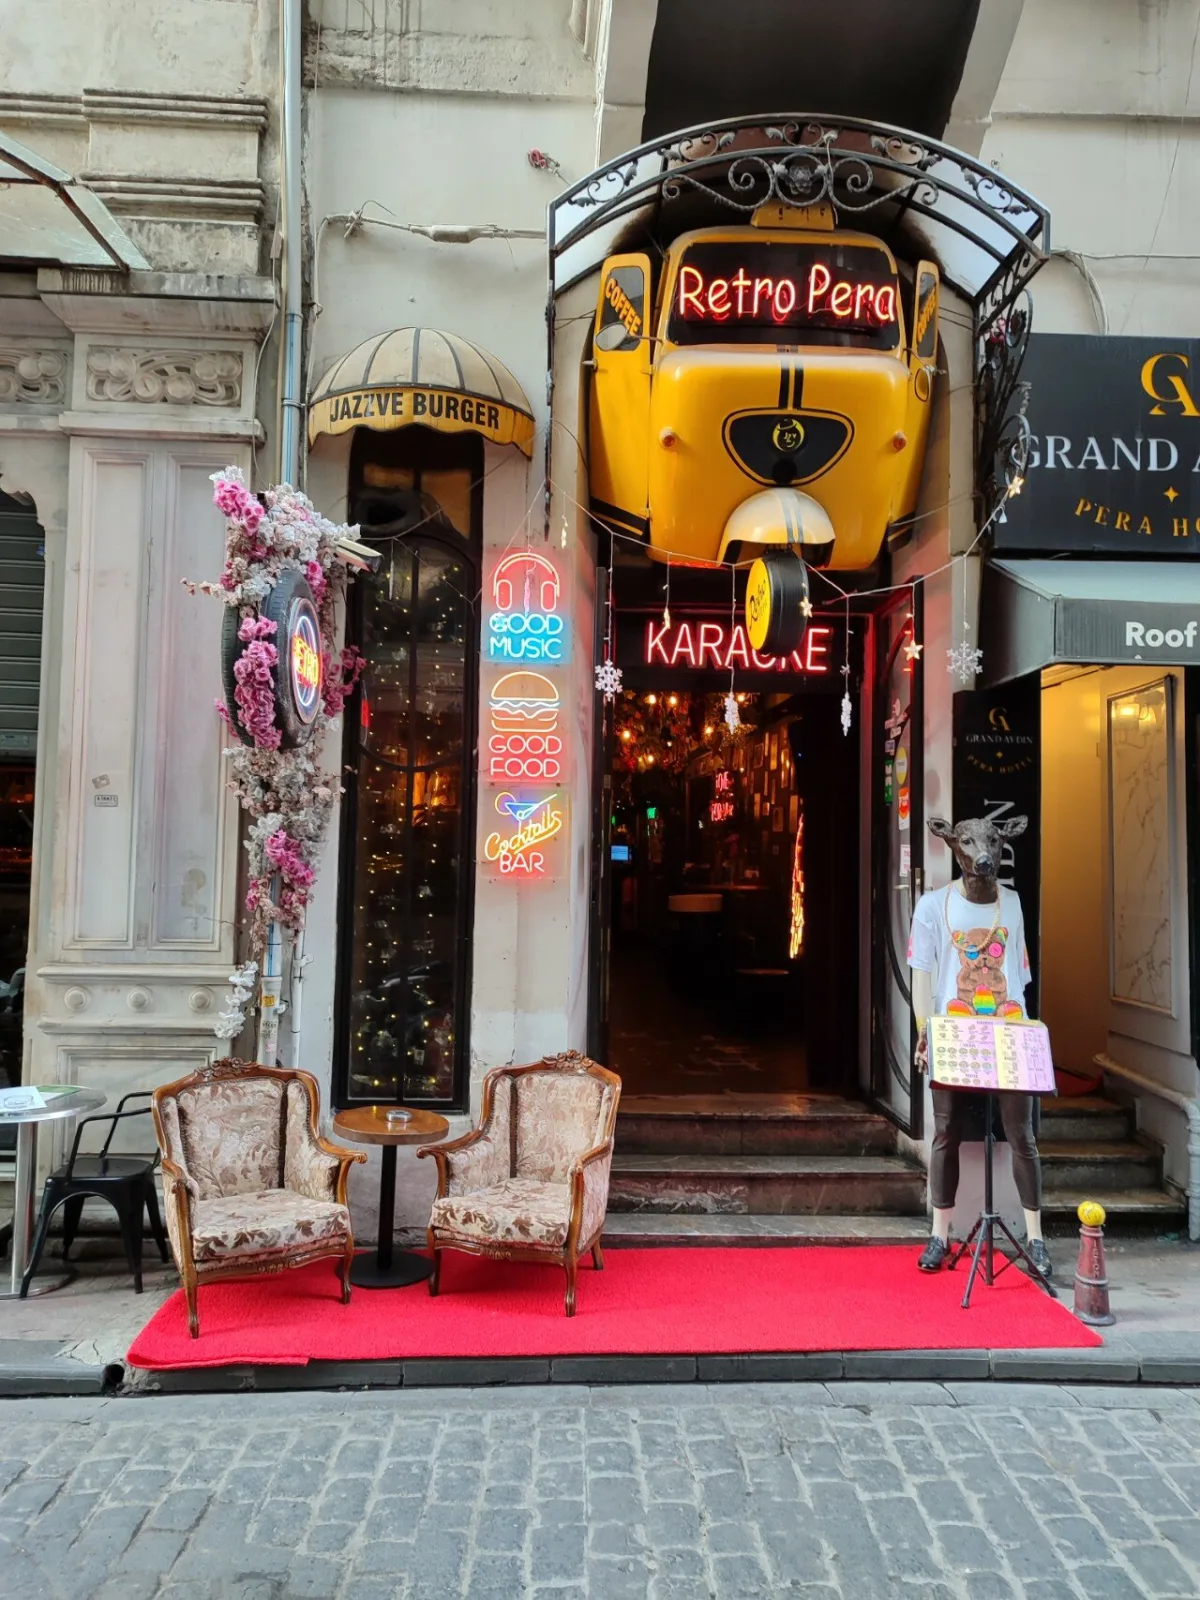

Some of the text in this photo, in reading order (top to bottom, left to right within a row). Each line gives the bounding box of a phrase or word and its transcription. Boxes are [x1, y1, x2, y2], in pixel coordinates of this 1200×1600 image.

[680, 263, 895, 322] Retro Pera
[605, 277, 642, 337] COFFEE
[330, 391, 499, 430] JAZZVE BURGER
[1011, 434, 1179, 472] GRAND
[1074, 498, 1153, 535] PERA
[489, 612, 563, 635] GOOD
[1125, 620, 1198, 648] Roof
[489, 636, 562, 659] MUSIC
[647, 622, 830, 671] KARAE
[488, 734, 562, 755] GOOD
[966, 734, 1001, 743] GRAND
[490, 757, 560, 778] FOOD
[500, 851, 545, 873] BAR
